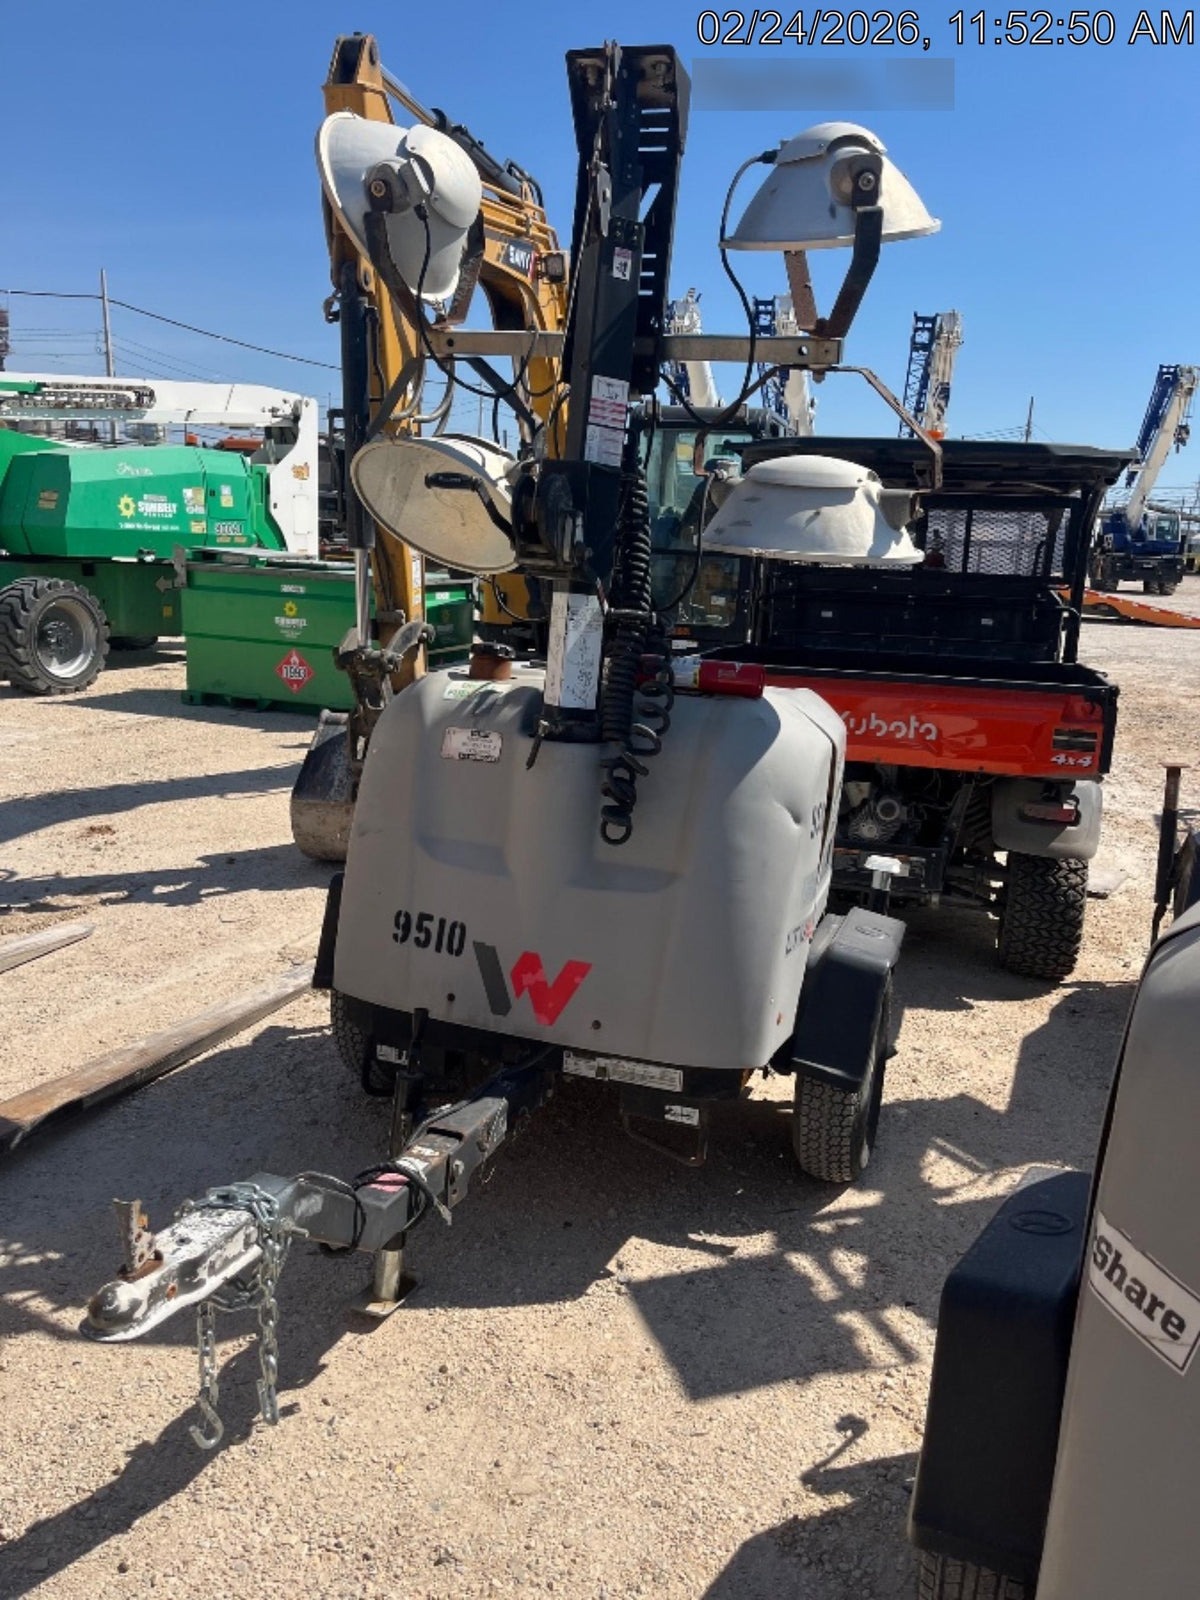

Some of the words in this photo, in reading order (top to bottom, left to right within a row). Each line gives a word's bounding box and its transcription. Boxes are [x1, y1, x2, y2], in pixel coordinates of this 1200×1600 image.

[1051, 752, 1093, 768] 4x4
[392, 909, 467, 957] 9510
[1092, 1234, 1187, 1341] Share
